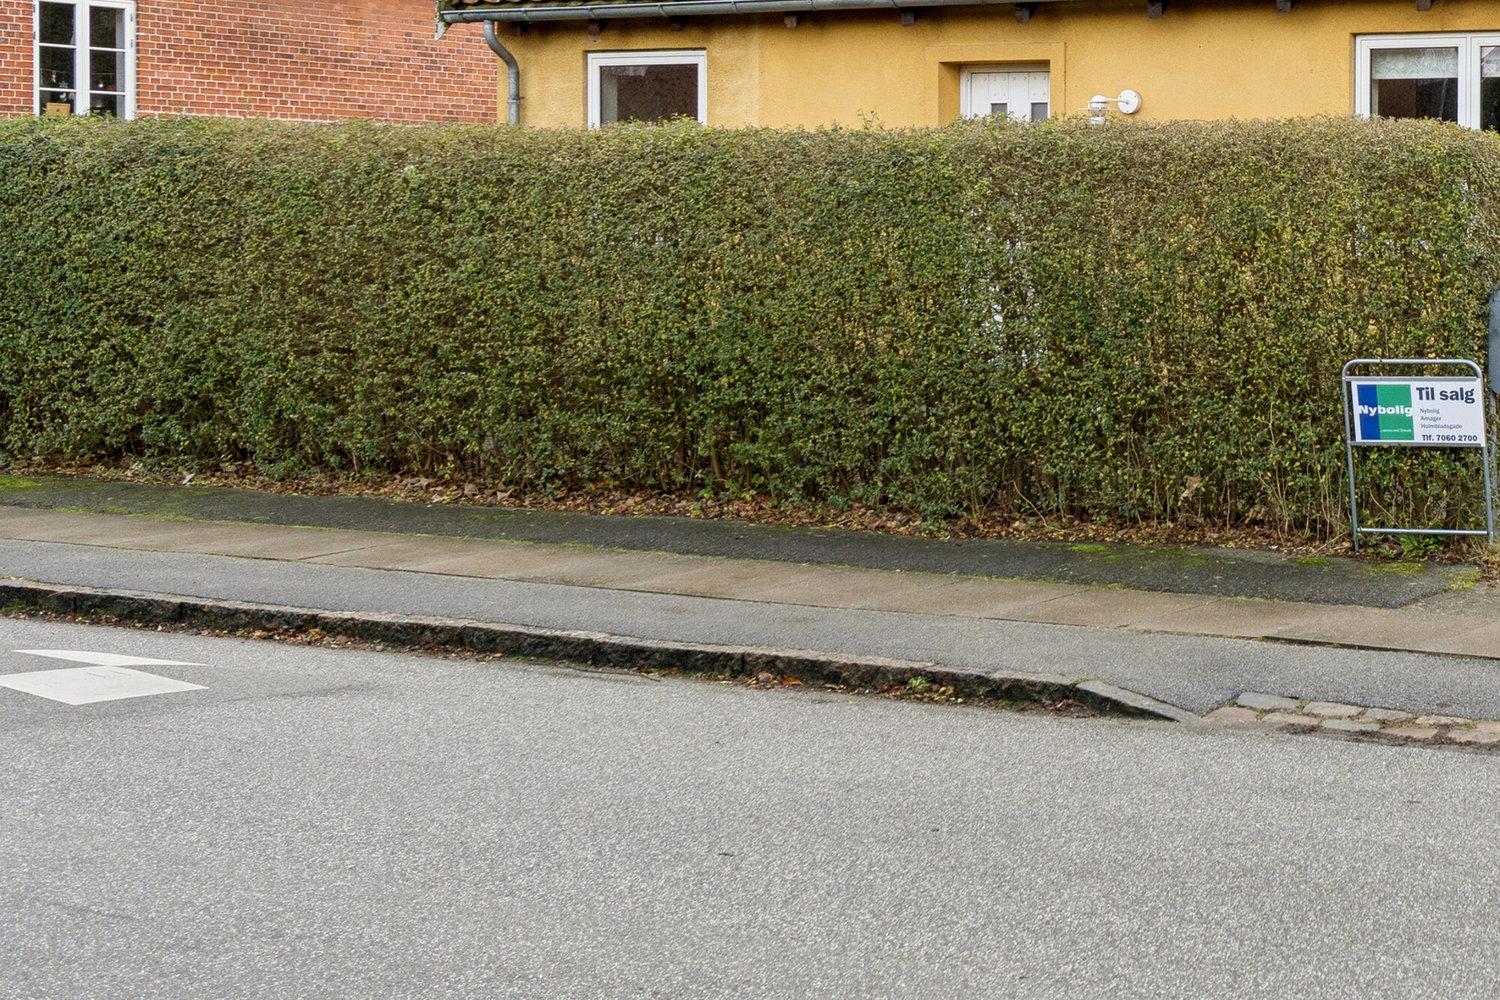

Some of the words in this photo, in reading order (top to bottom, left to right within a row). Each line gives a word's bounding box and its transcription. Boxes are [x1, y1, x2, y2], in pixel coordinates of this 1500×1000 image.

[1416, 387, 1435, 401] Til
[1439, 387, 1475, 404] salg
[1358, 405, 1413, 417] Nybolig
[1422, 434, 1435, 442] Tlf.
[1437, 434, 1456, 442] 7060
[1458, 434, 1478, 442] 2700
